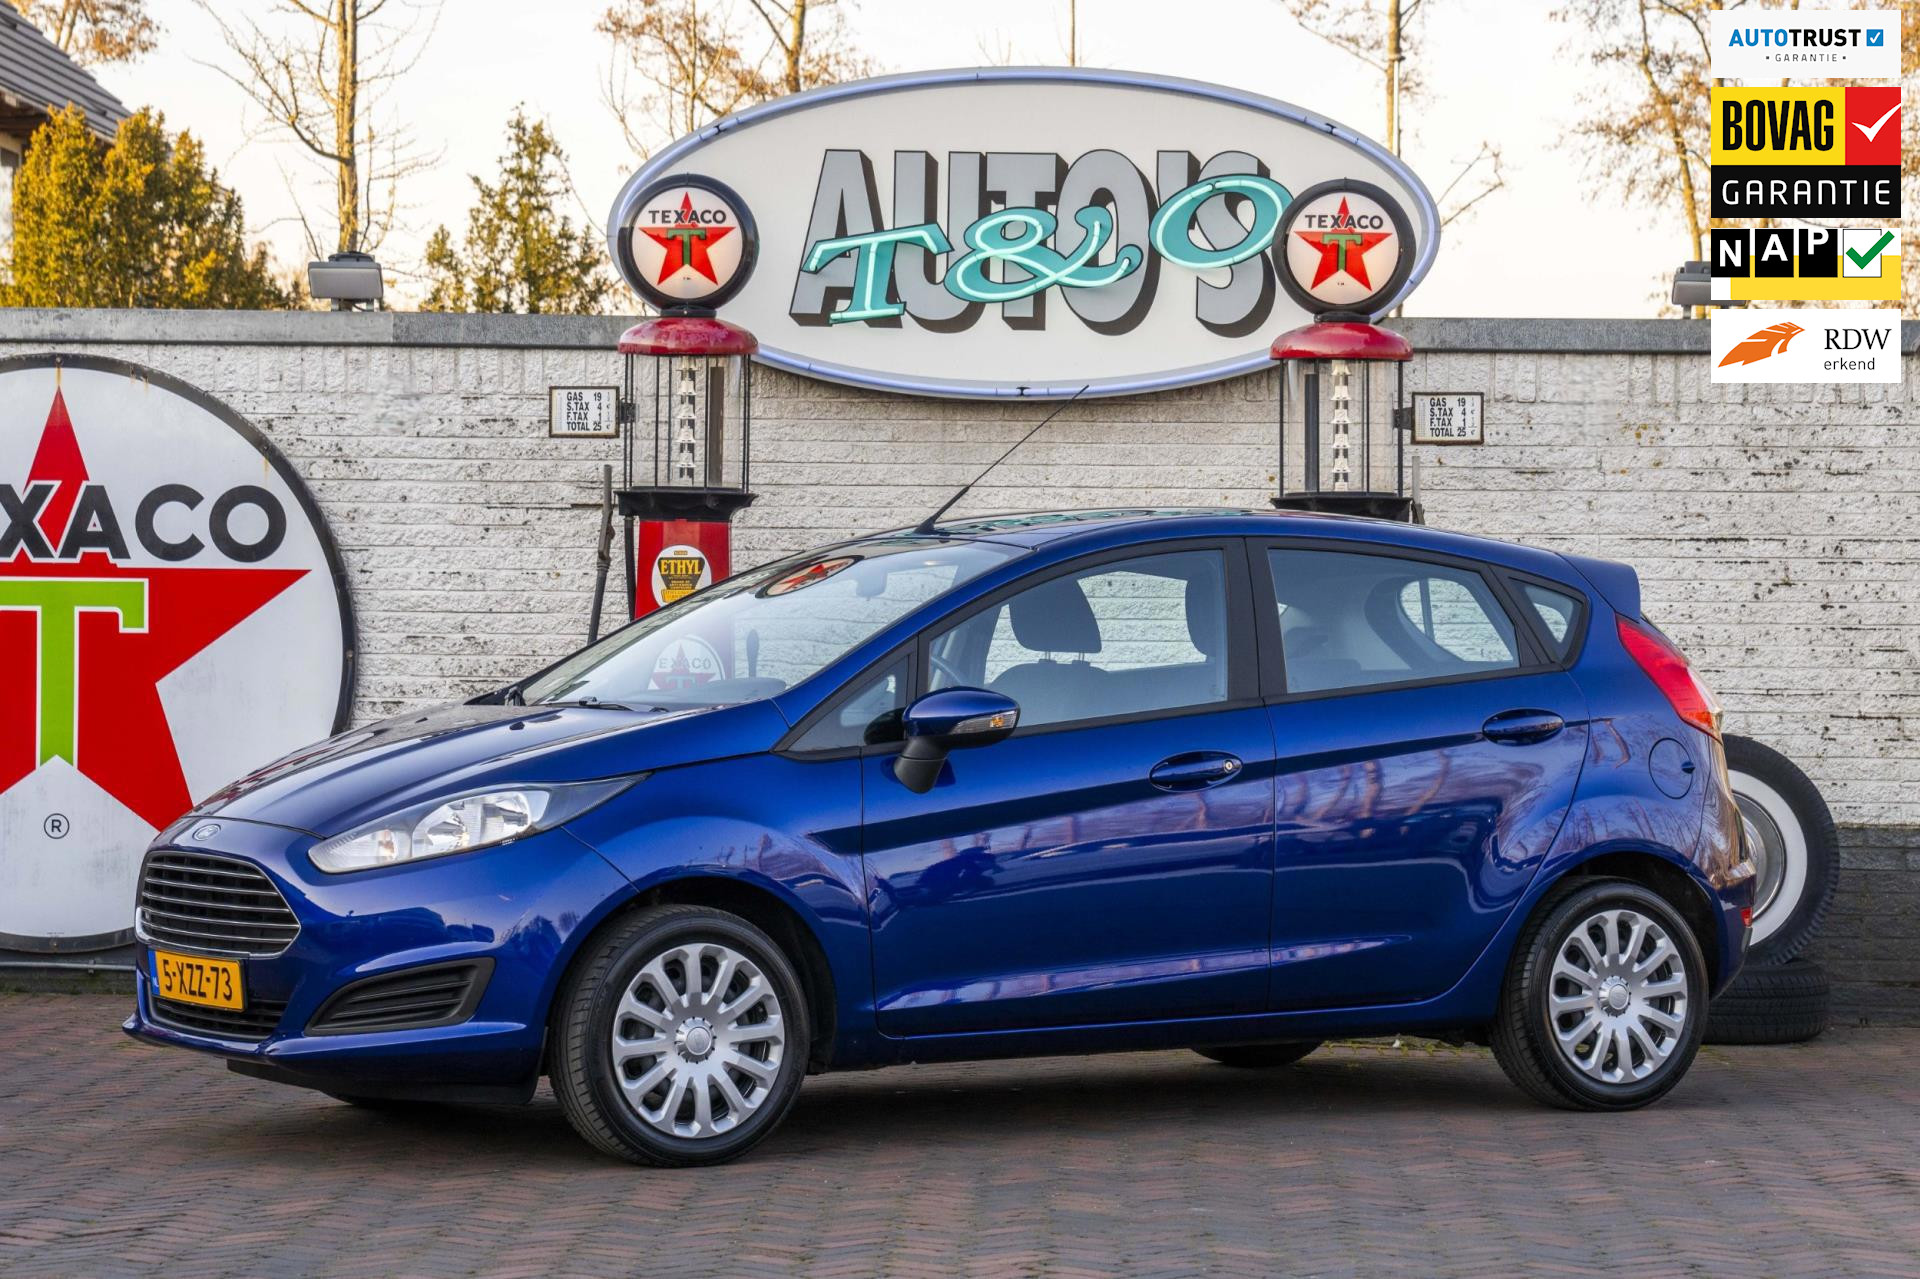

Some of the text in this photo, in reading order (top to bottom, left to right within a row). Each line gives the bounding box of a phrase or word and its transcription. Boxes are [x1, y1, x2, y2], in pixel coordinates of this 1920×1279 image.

[648, 209, 727, 225] TEXACO
[1304, 214, 1384, 230] TEXACO
[666, 229, 707, 266] T
[789, 149, 1276, 337] AUTO'S
[1322, 233, 1363, 271] T
[566, 391, 584, 402] GAS
[593, 391, 602, 402] 19
[566, 401, 590, 411] S.TAX
[1429, 397, 1447, 408] GAS
[1457, 397, 1466, 408] 19
[566, 411, 589, 421] F.TAX
[1429, 407, 1453, 417] S.TAX
[1461, 407, 1467, 417] 4
[566, 421, 591, 431] TOTAL
[592, 421, 602, 431] 25
[1429, 417, 1452, 427] F.TAX
[1429, 427, 1455, 437] TOTAL
[1457, 427, 1467, 437] 25
[660, 559, 702, 575] ETHYL
[162, 958, 233, 1002] 5-XZZ-73
